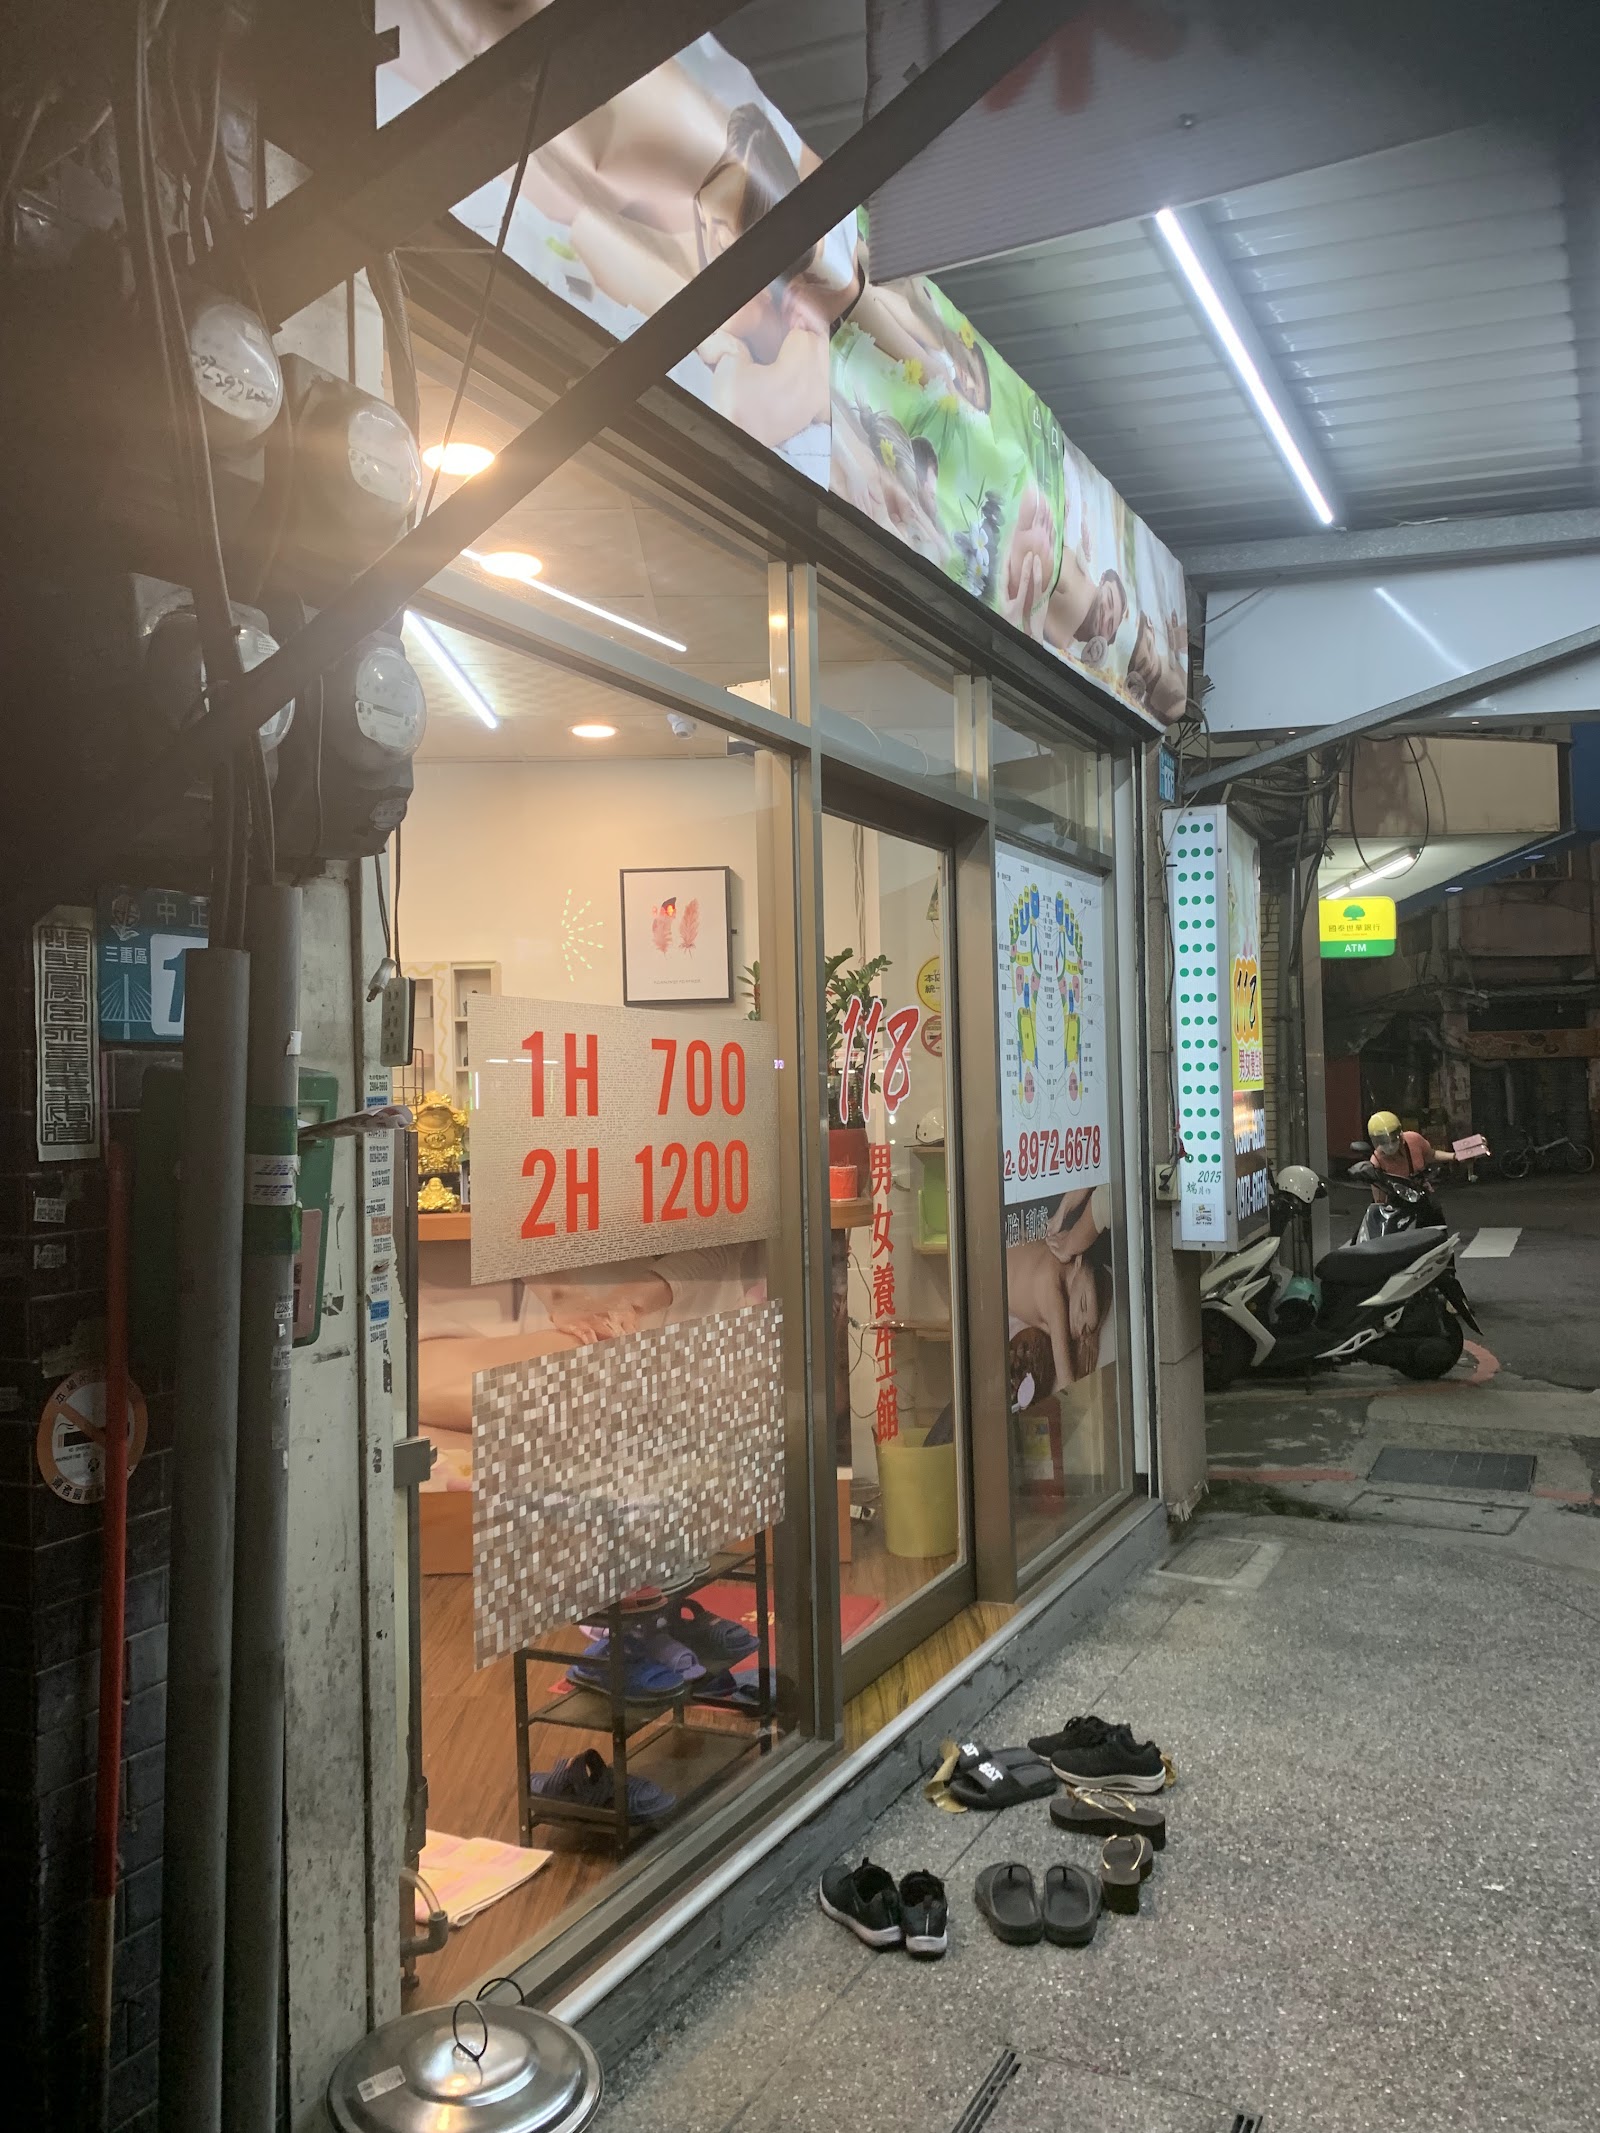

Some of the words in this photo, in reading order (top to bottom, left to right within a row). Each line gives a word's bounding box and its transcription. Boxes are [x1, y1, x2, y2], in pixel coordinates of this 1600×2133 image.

[105, 946, 148, 965] 三重區
[1344, 944, 1367, 953] ATM
[1235, 969, 1258, 1033] 118
[521, 1031, 599, 1117] 1H
[651, 1038, 746, 1116] 700
[838, 995, 919, 1124] 118
[521, 1147, 599, 1239] 2H
[635, 1139, 749, 1223] 1200
[1197, 1170, 1222, 1184] 2015
[869, 1143, 900, 1445] 男女養生館
